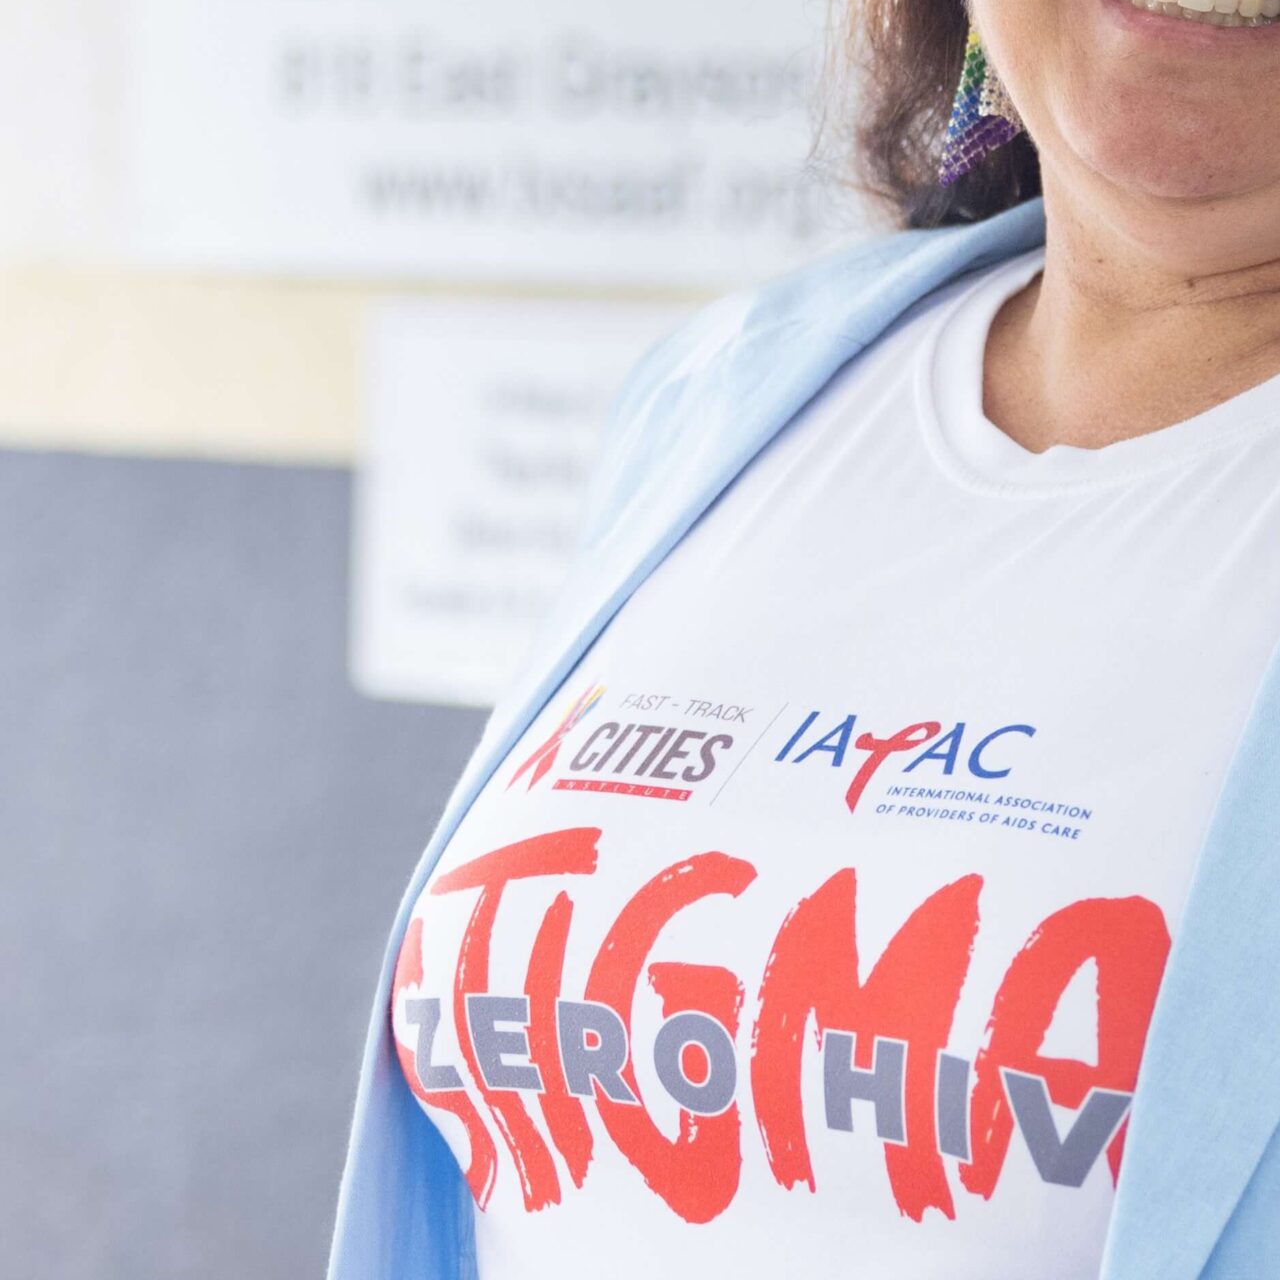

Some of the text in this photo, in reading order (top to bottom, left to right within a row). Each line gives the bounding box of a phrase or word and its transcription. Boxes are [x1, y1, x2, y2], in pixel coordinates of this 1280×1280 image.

[619, 694, 670, 711] FAST
[684, 699, 753, 723] TRACK
[569, 721, 734, 783] CITIES
[554, 780, 691, 801] INSTITUTE
[887, 785, 1092, 820] INTERNATIONAL ASSOCIATION
[876, 803, 1081, 840] OF PROVIDERS OF AIDS CARE
[404, 995, 1134, 1189] ZERO HIV
